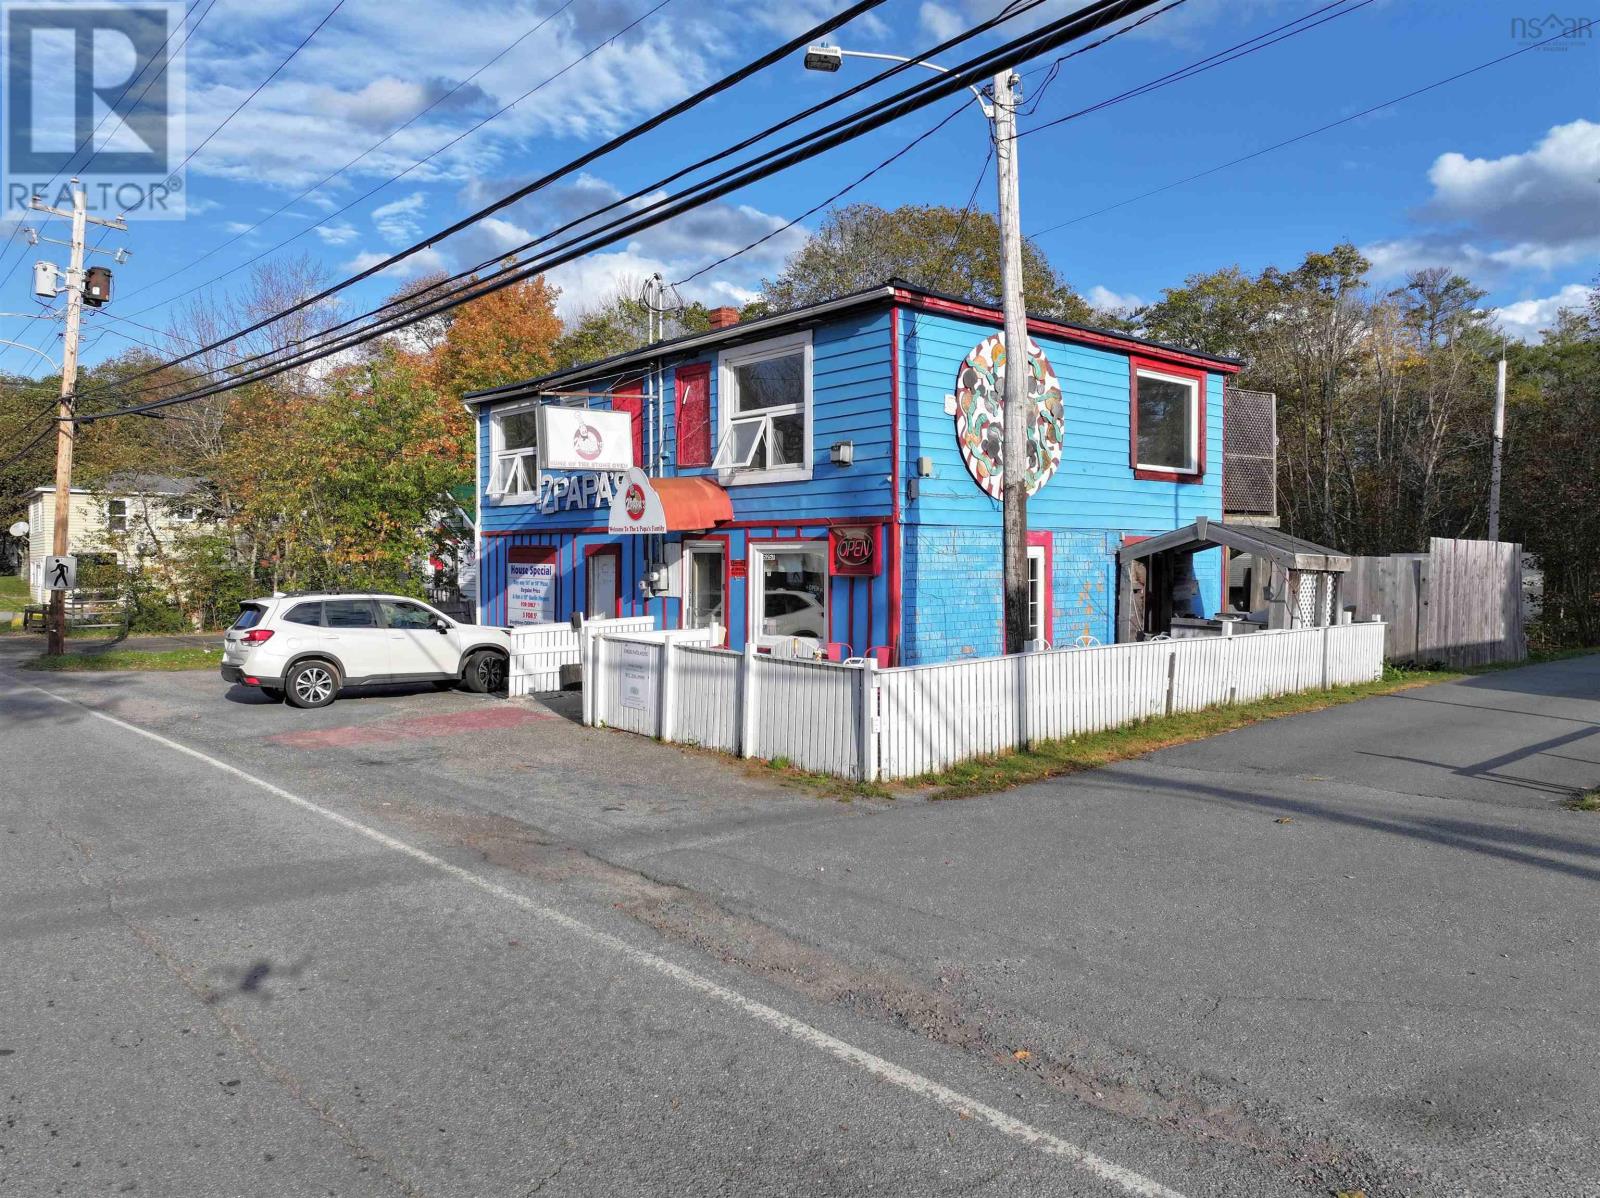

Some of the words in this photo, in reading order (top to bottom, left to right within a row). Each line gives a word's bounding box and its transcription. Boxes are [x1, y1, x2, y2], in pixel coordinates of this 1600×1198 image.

[840, 540, 870, 556] OPEN
[510, 565, 529, 575] House
[530, 564, 552, 577] Special
